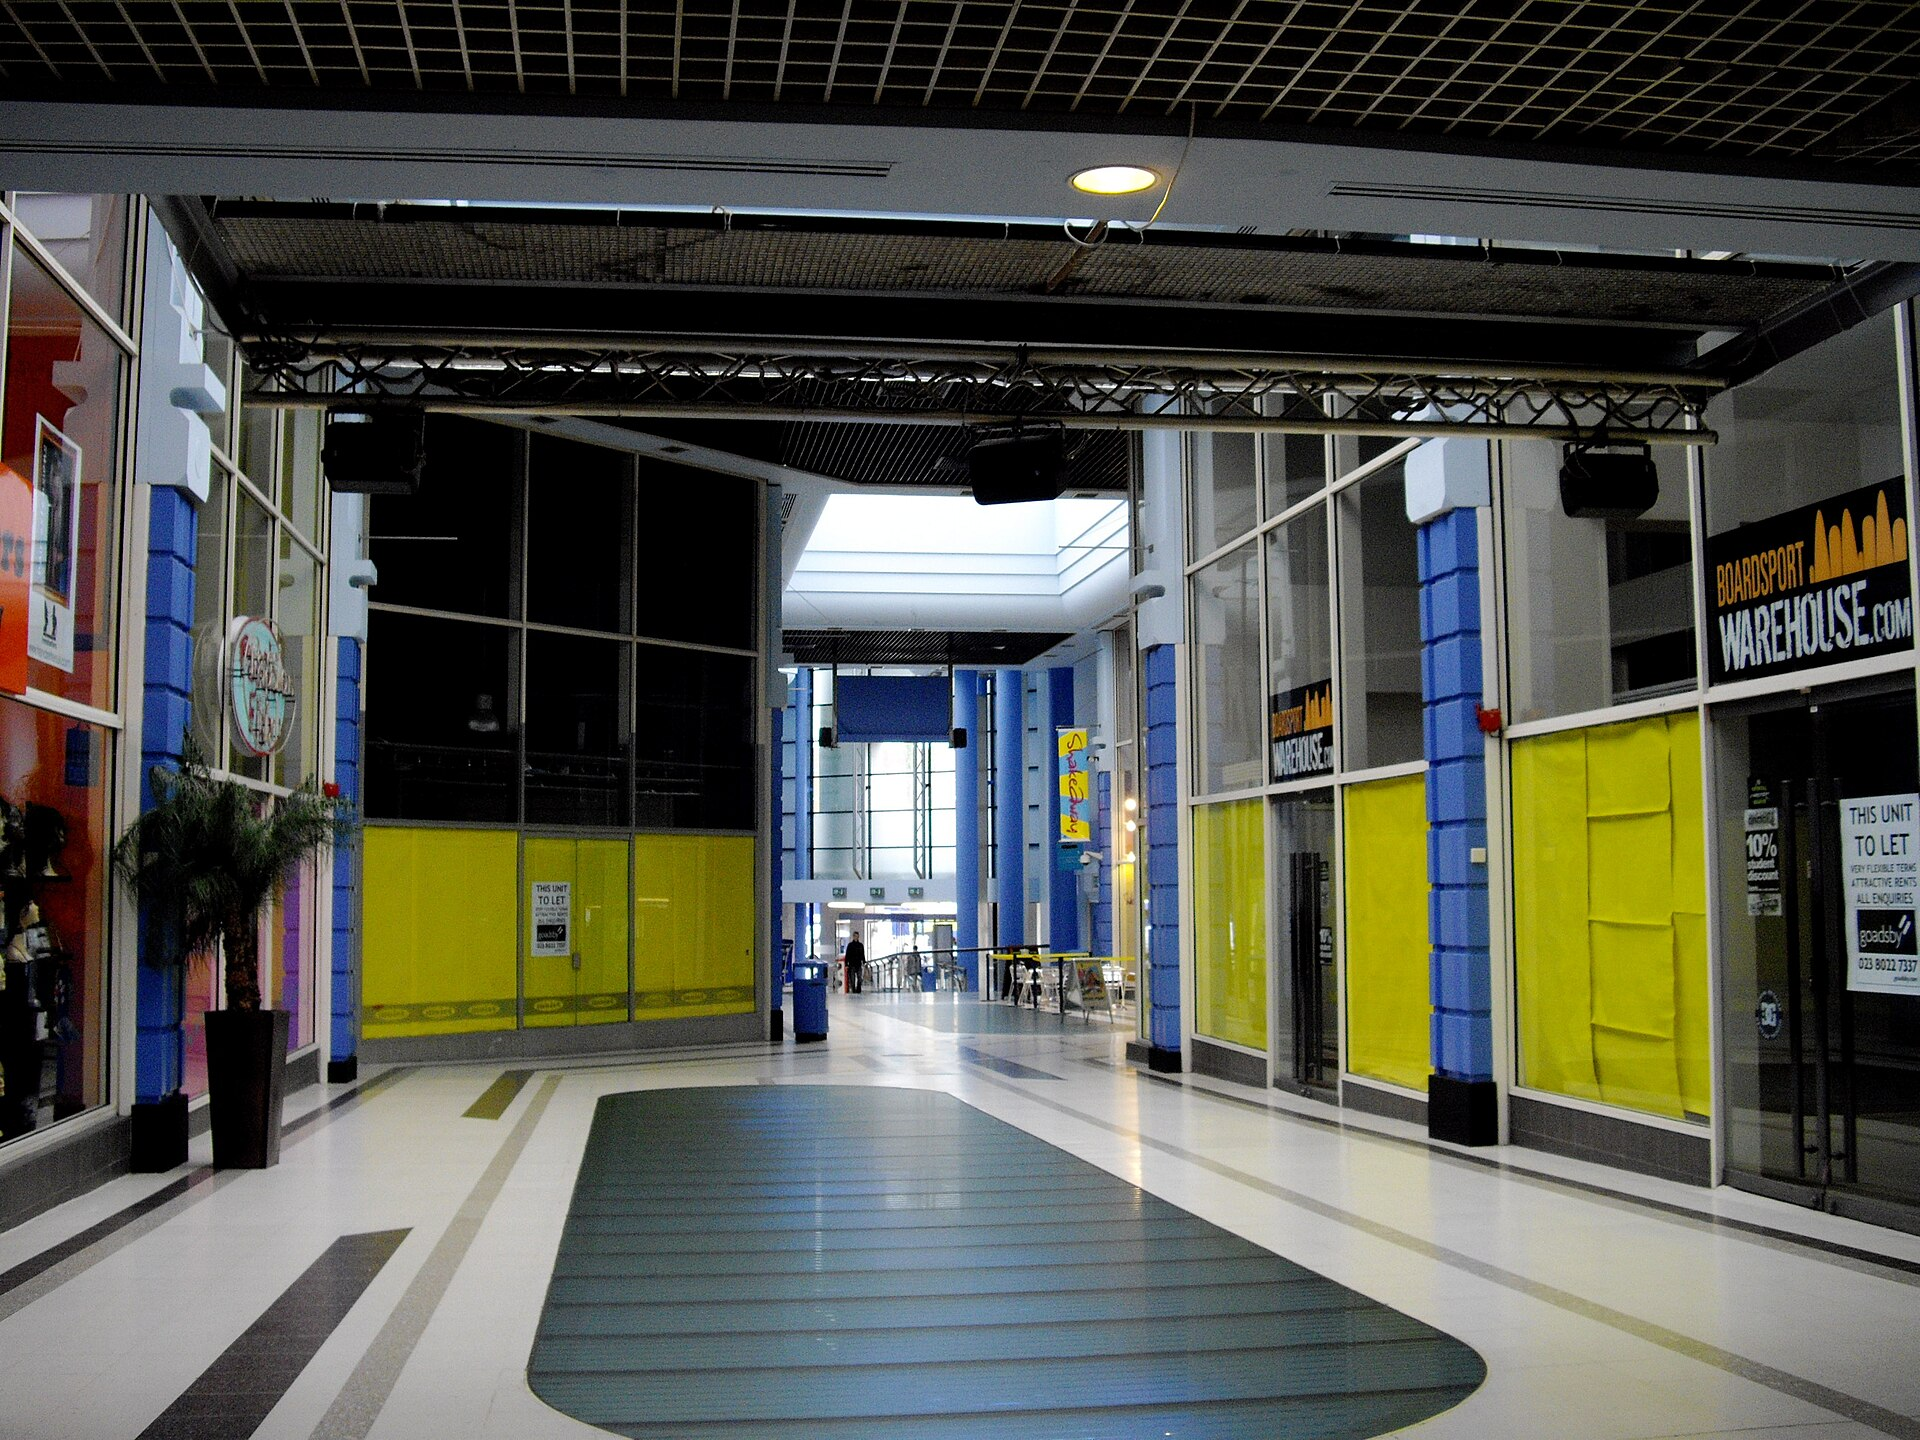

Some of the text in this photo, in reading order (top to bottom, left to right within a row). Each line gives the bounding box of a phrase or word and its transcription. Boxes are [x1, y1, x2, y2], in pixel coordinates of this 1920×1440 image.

[1717, 541, 1804, 608] BOARDSPORT
[1849, 803, 1913, 825] THIS UNIT
[1746, 833, 1777, 858] 10%
[1855, 833, 1909, 856] TO LET
[1850, 863, 1917, 874] VERY FLEXIBLE TERMS
[536, 884, 568, 893] THIS UNIT
[1851, 876, 1917, 888] ATTRACTIVE RENTS
[538, 896, 566, 905] TO LET
[1857, 892, 1913, 906] ALL ENQUIRIES
[1859, 925, 1903, 949] goadsby
[1859, 957, 1918, 972] 023 8022 7337
